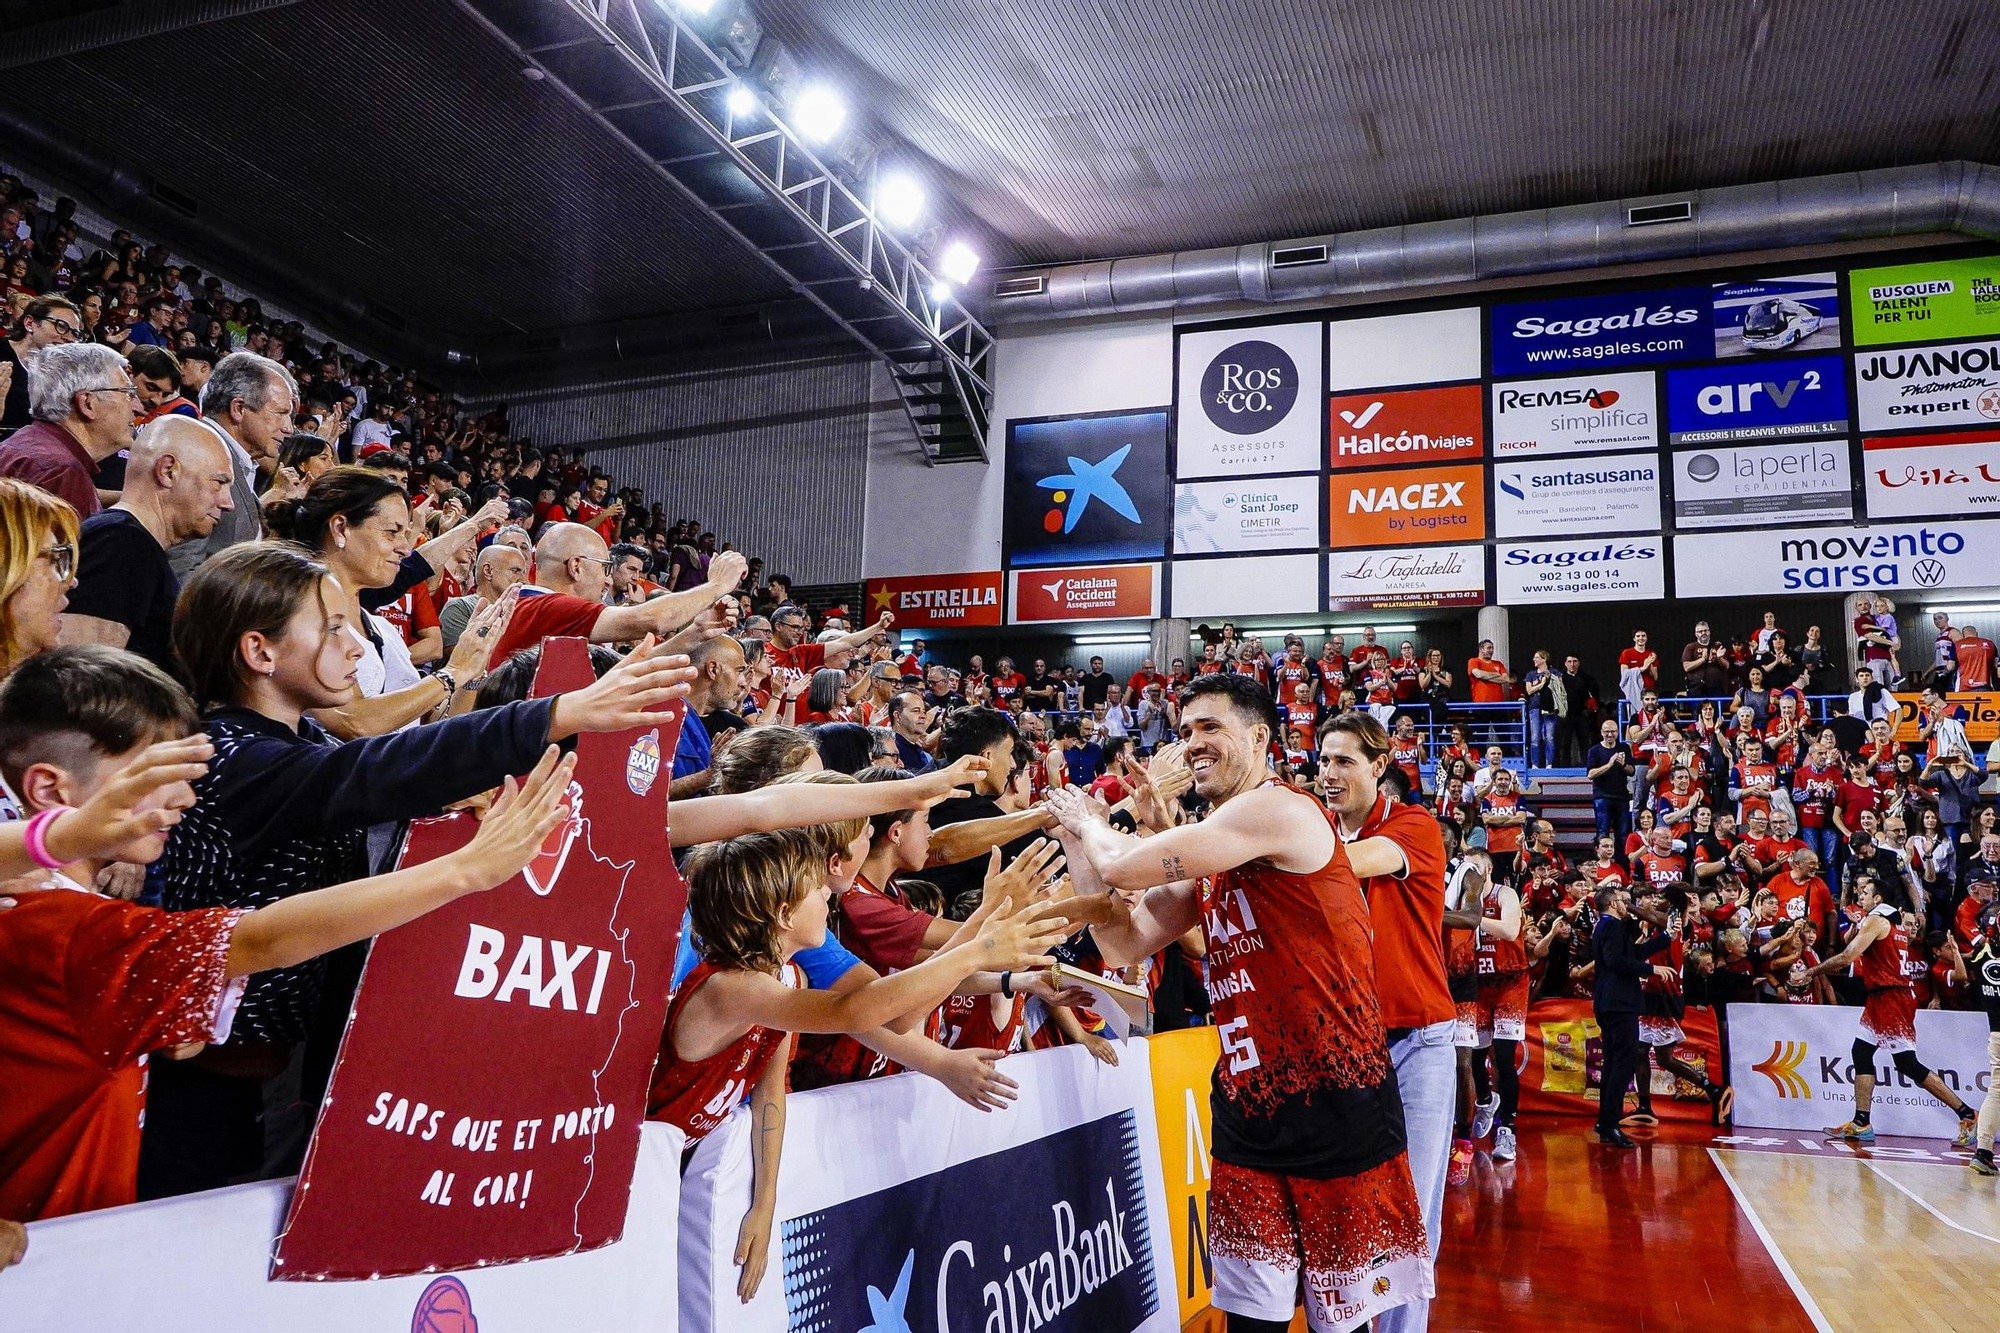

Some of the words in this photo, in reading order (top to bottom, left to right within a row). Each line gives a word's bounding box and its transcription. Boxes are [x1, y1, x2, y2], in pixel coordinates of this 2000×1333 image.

[1971, 278, 1992, 286] THE
[1872, 282, 1951, 298] BUSQUEM
[1972, 286, 2000, 294] TALE
[1873, 296, 1928, 310] TALENT
[1512, 305, 1698, 338] Sagalés
[1874, 311, 1902, 324] PER
[1906, 310, 1932, 321] TU!
[1526, 338, 1684, 362] www.sagales.com
[1220, 363, 1281, 392] Ros
[1901, 376, 1998, 397] Photomaton
[1500, 388, 1600, 414] REMSA
[1888, 398, 1970, 417] expert
[1550, 408, 1648, 433] simplifica
[1682, 431, 1728, 442] ACCESSORIS
[1736, 427, 1775, 438] RECANVIS
[1822, 424, 1836, 432] S.L.
[1212, 440, 1285, 453] Assessors
[1500, 440, 1537, 450] RICOH
[1531, 468, 1654, 488] santasusana
[1241, 493, 1278, 503] Clínica
[1348, 482, 1466, 514] NACEX
[1532, 491, 1550, 499] Grup
[1550, 490, 1560, 498] de
[1562, 488, 1596, 497] corredors
[1240, 504, 1266, 514] Sant
[1268, 503, 1299, 513] Josep
[1517, 508, 1548, 516] Manresa
[1558, 506, 1596, 514] Barcelona
[1240, 518, 1280, 528] CIMETIR
[1389, 518, 1406, 530] by
[1542, 514, 1616, 524] www.santasusana.com
[1780, 528, 1964, 562] movento
[1504, 544, 1656, 567] Sagalés
[1540, 571, 1564, 581] 902
[1568, 570, 1581, 580] 13
[1584, 570, 1602, 580] 00
[1604, 568, 1620, 578] 14
[1783, 563, 1898, 590] sarsa
[1066, 577, 1118, 590] Catalana
[1386, 582, 1426, 590] MANRESA
[1522, 580, 1639, 593] www.sagales.com
[900, 586, 998, 609] ESTRELLA
[1066, 588, 1116, 601] Occident
[1066, 599, 1116, 609] Assegurances
[930, 607, 965, 619] DAMM
[630, 749, 659, 775] BAXI
[454, 922, 612, 1015] BAXI
[1478, 958, 1496, 974] 23
[1822, 1091, 1846, 1102] Una
[1886, 1094, 1900, 1105] de
[366, 1091, 446, 1142] SAPS
[452, 1116, 498, 1152] QUE
[512, 1118, 543, 1151] ET
[550, 1102, 615, 1145] PORTO
[420, 1170, 454, 1208] AL
[472, 1169, 533, 1210] COR!
[936, 1176, 1134, 1333] CaixaBank
